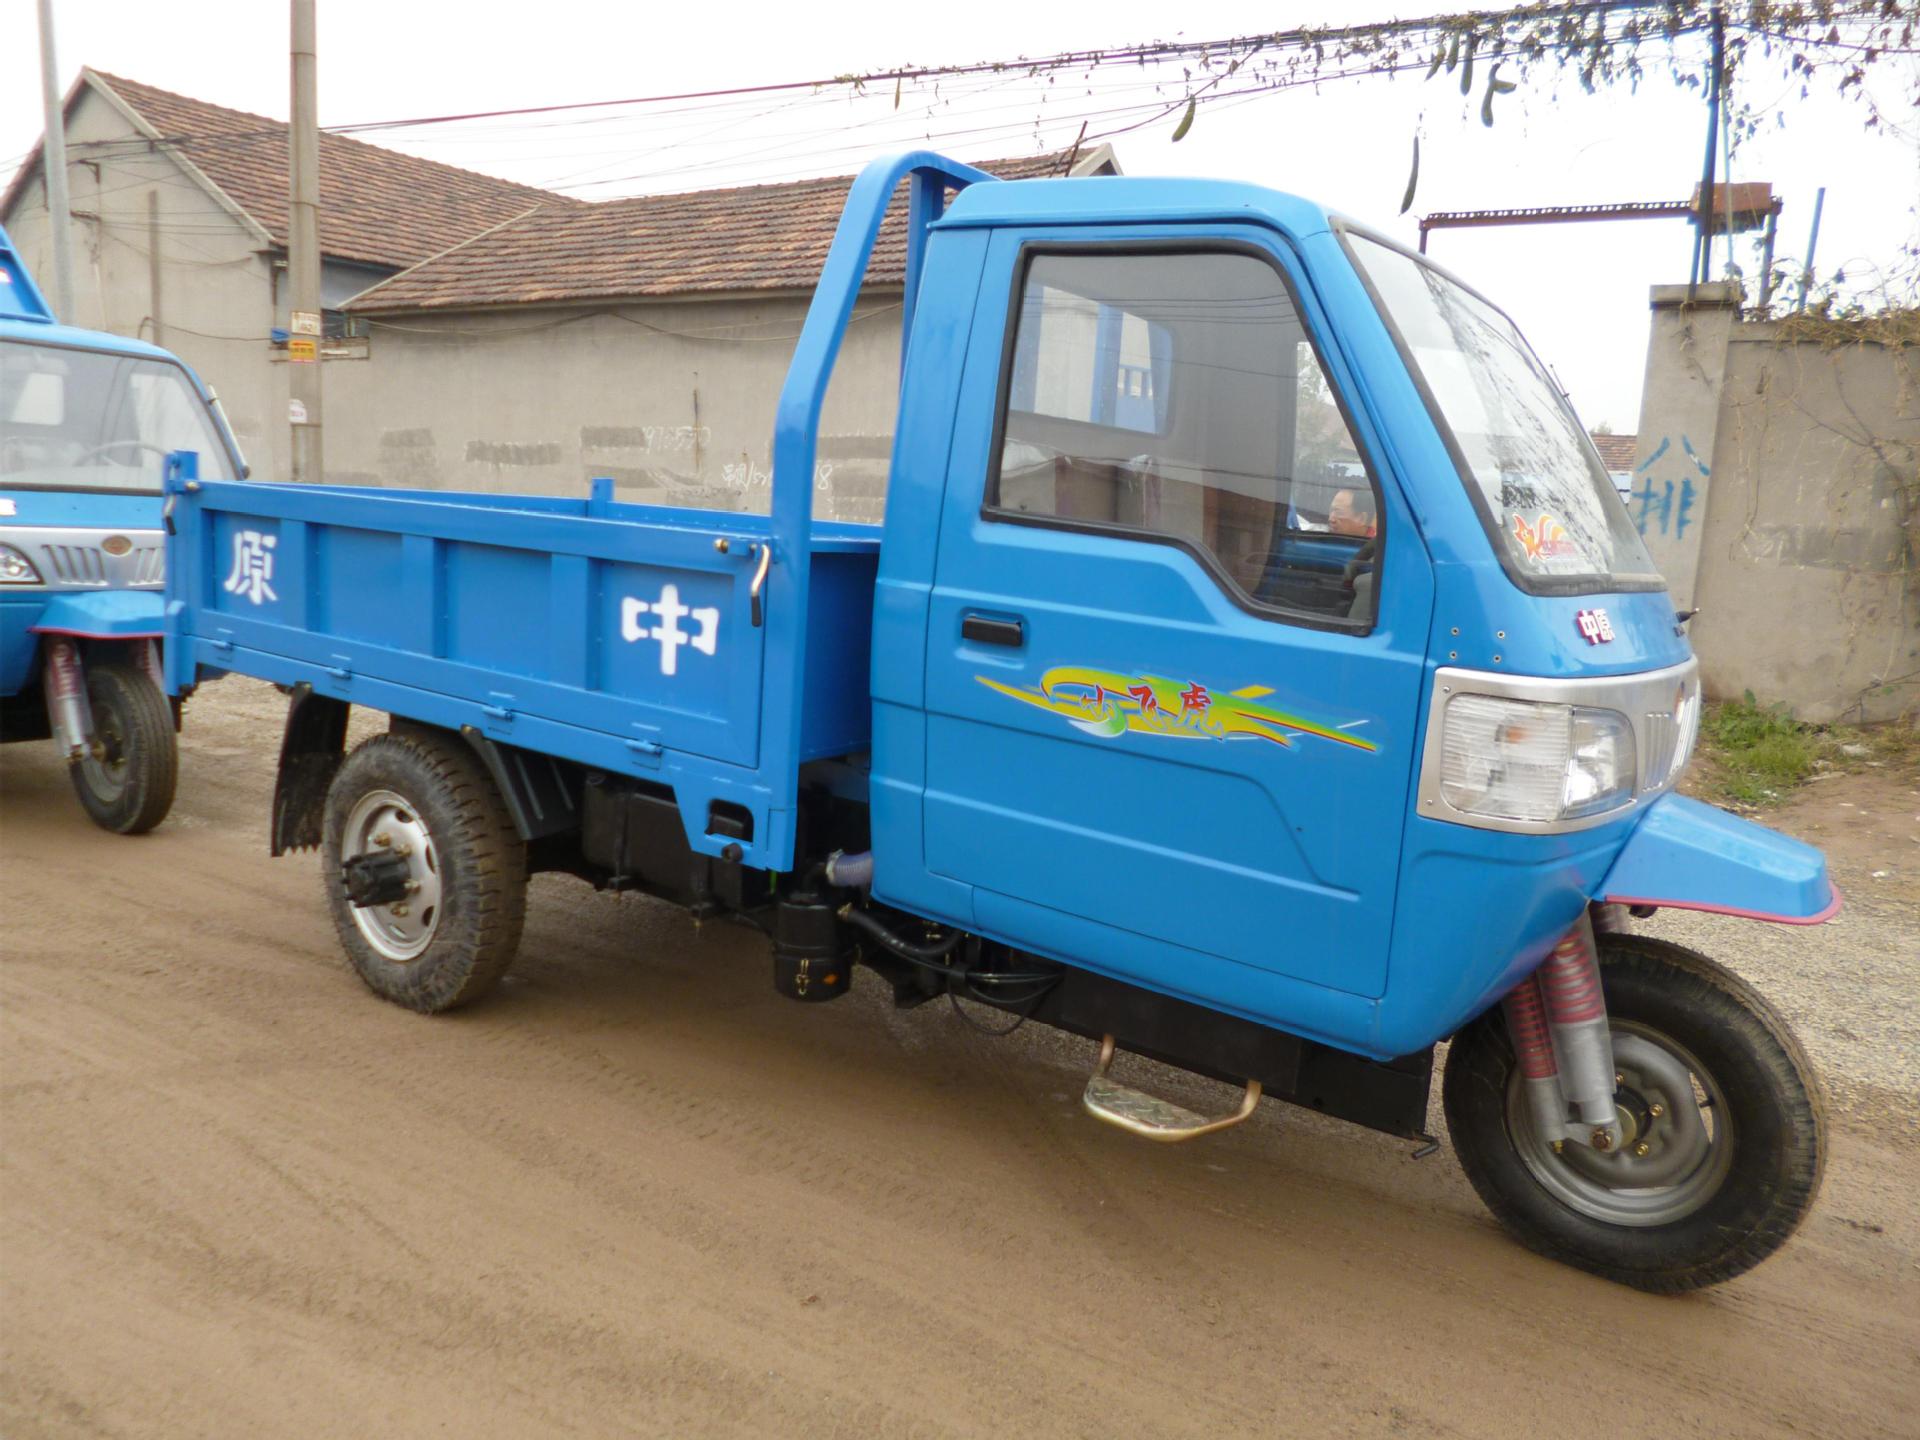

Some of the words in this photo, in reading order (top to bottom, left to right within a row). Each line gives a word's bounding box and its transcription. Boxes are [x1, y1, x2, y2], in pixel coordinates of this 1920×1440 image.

[224, 530, 278, 605] 原
[621, 583, 719, 676] 中
[1080, 680, 1225, 742] 小飞虎
